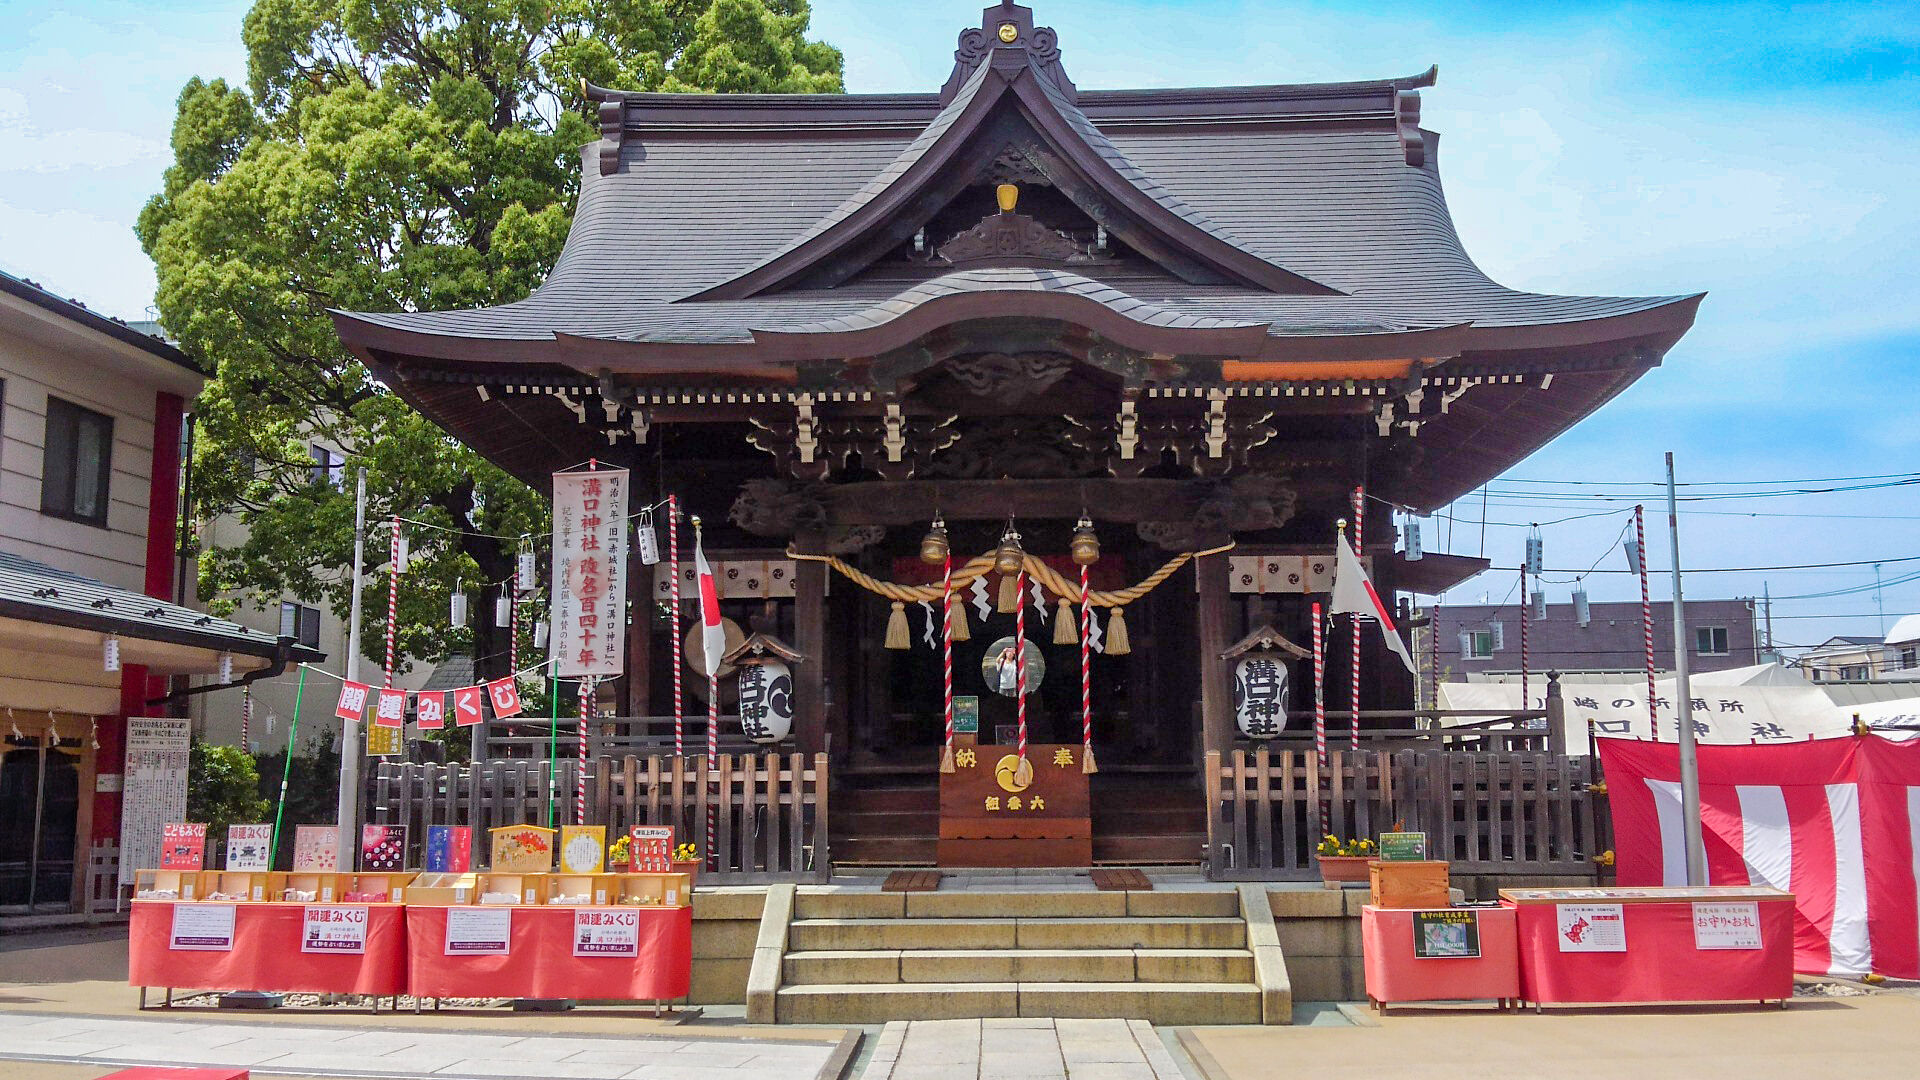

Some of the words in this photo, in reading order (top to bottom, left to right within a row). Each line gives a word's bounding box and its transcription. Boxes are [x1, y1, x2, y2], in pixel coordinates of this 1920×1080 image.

[609, 477, 619, 520] 明治六年
[1245, 659, 1281, 735] 溝口神社
[164, 825, 205, 837] こどもみくじ
[229, 827, 270, 839] 開運みくじ
[307, 910, 365, 923] 開運みくじ
[578, 913, 636, 926] 開運みくじ
[1697, 915, 1755, 928] お守り・お札
